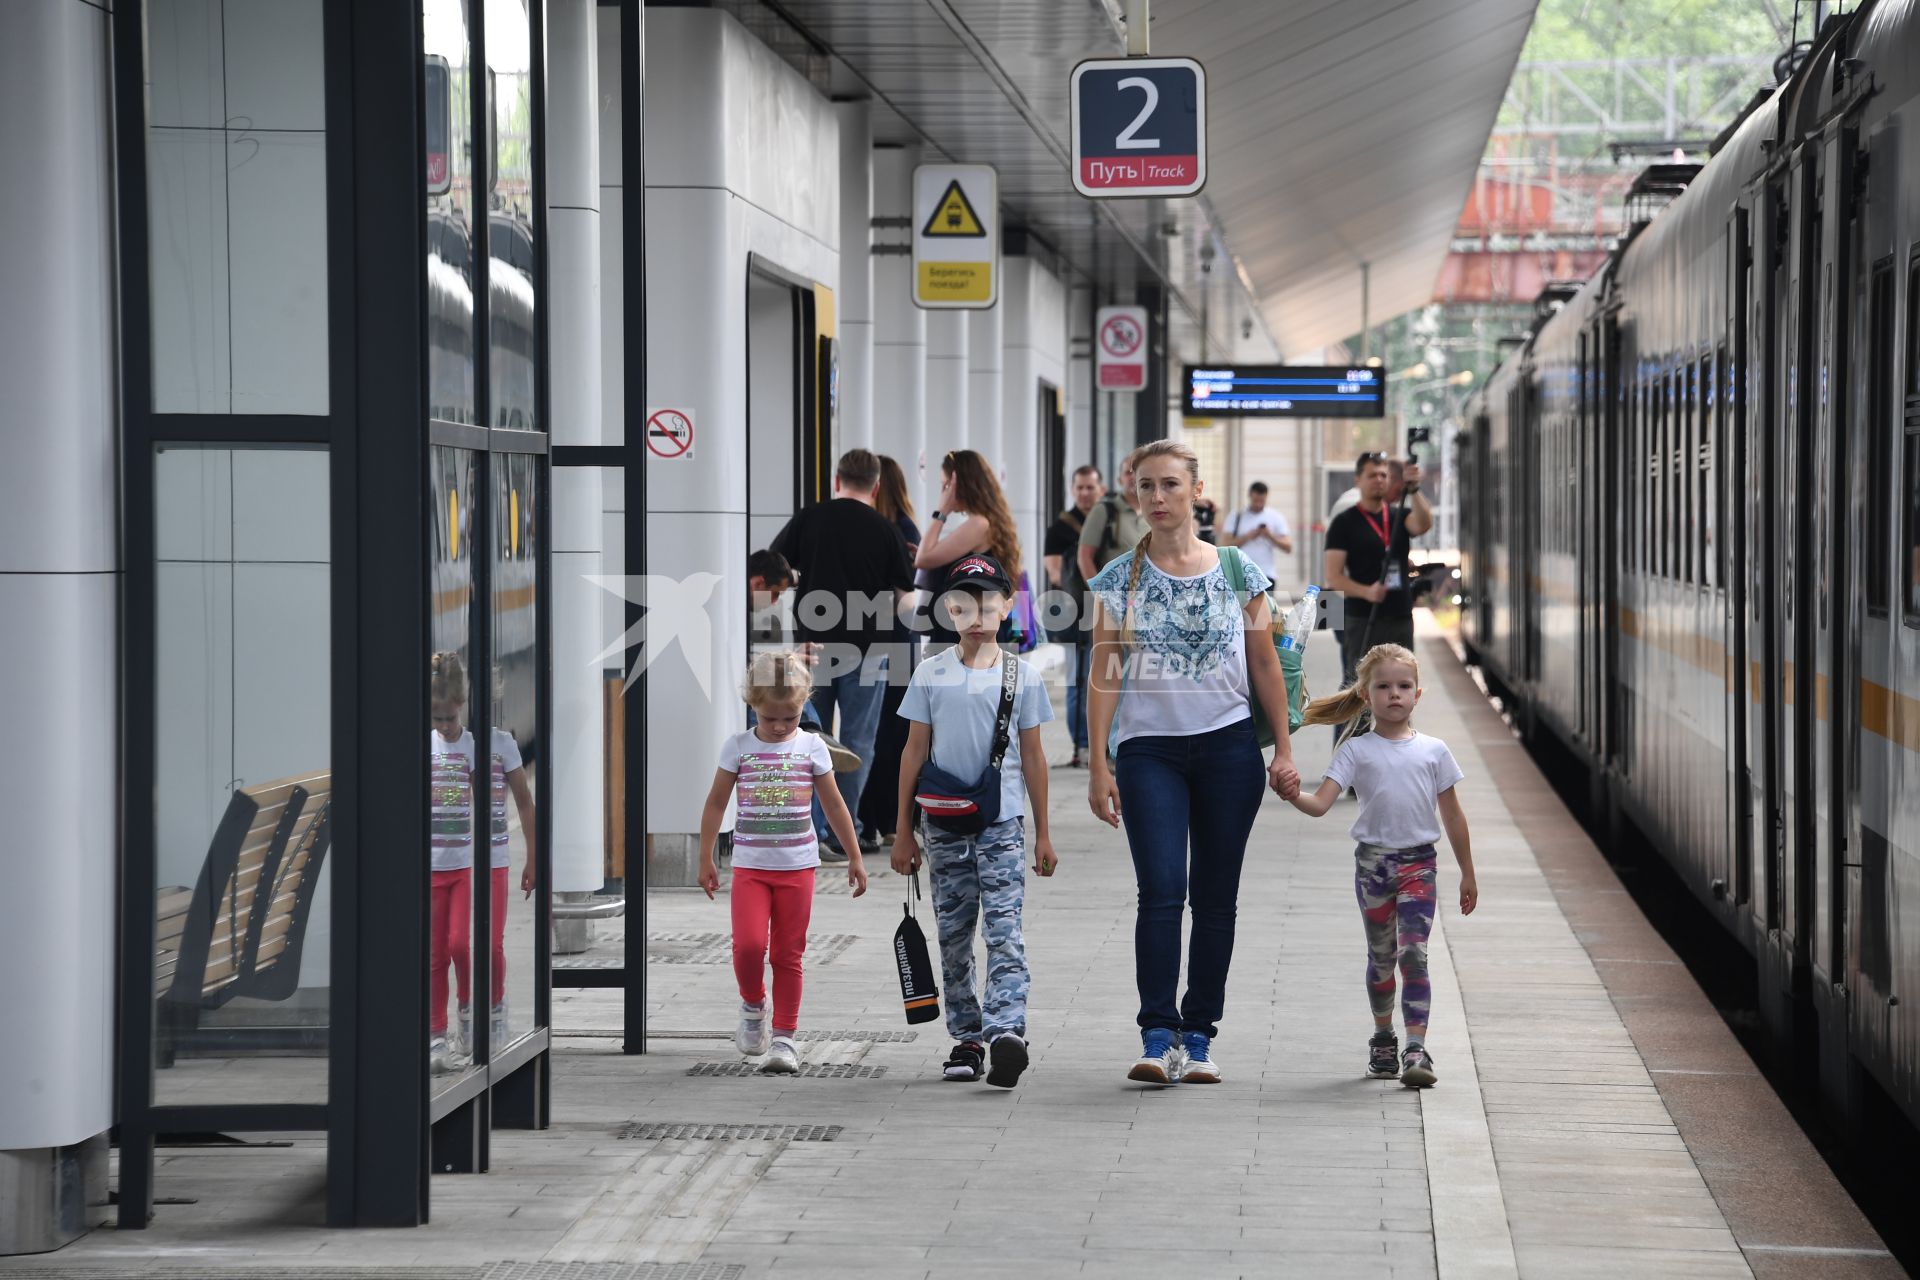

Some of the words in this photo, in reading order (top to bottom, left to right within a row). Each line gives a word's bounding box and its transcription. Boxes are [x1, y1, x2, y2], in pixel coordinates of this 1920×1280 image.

[1115, 76, 1161, 150] 2
[1090, 161, 1138, 184] Путь
[1148, 164, 1185, 178] Track
[1004, 659, 1017, 702] adidas
